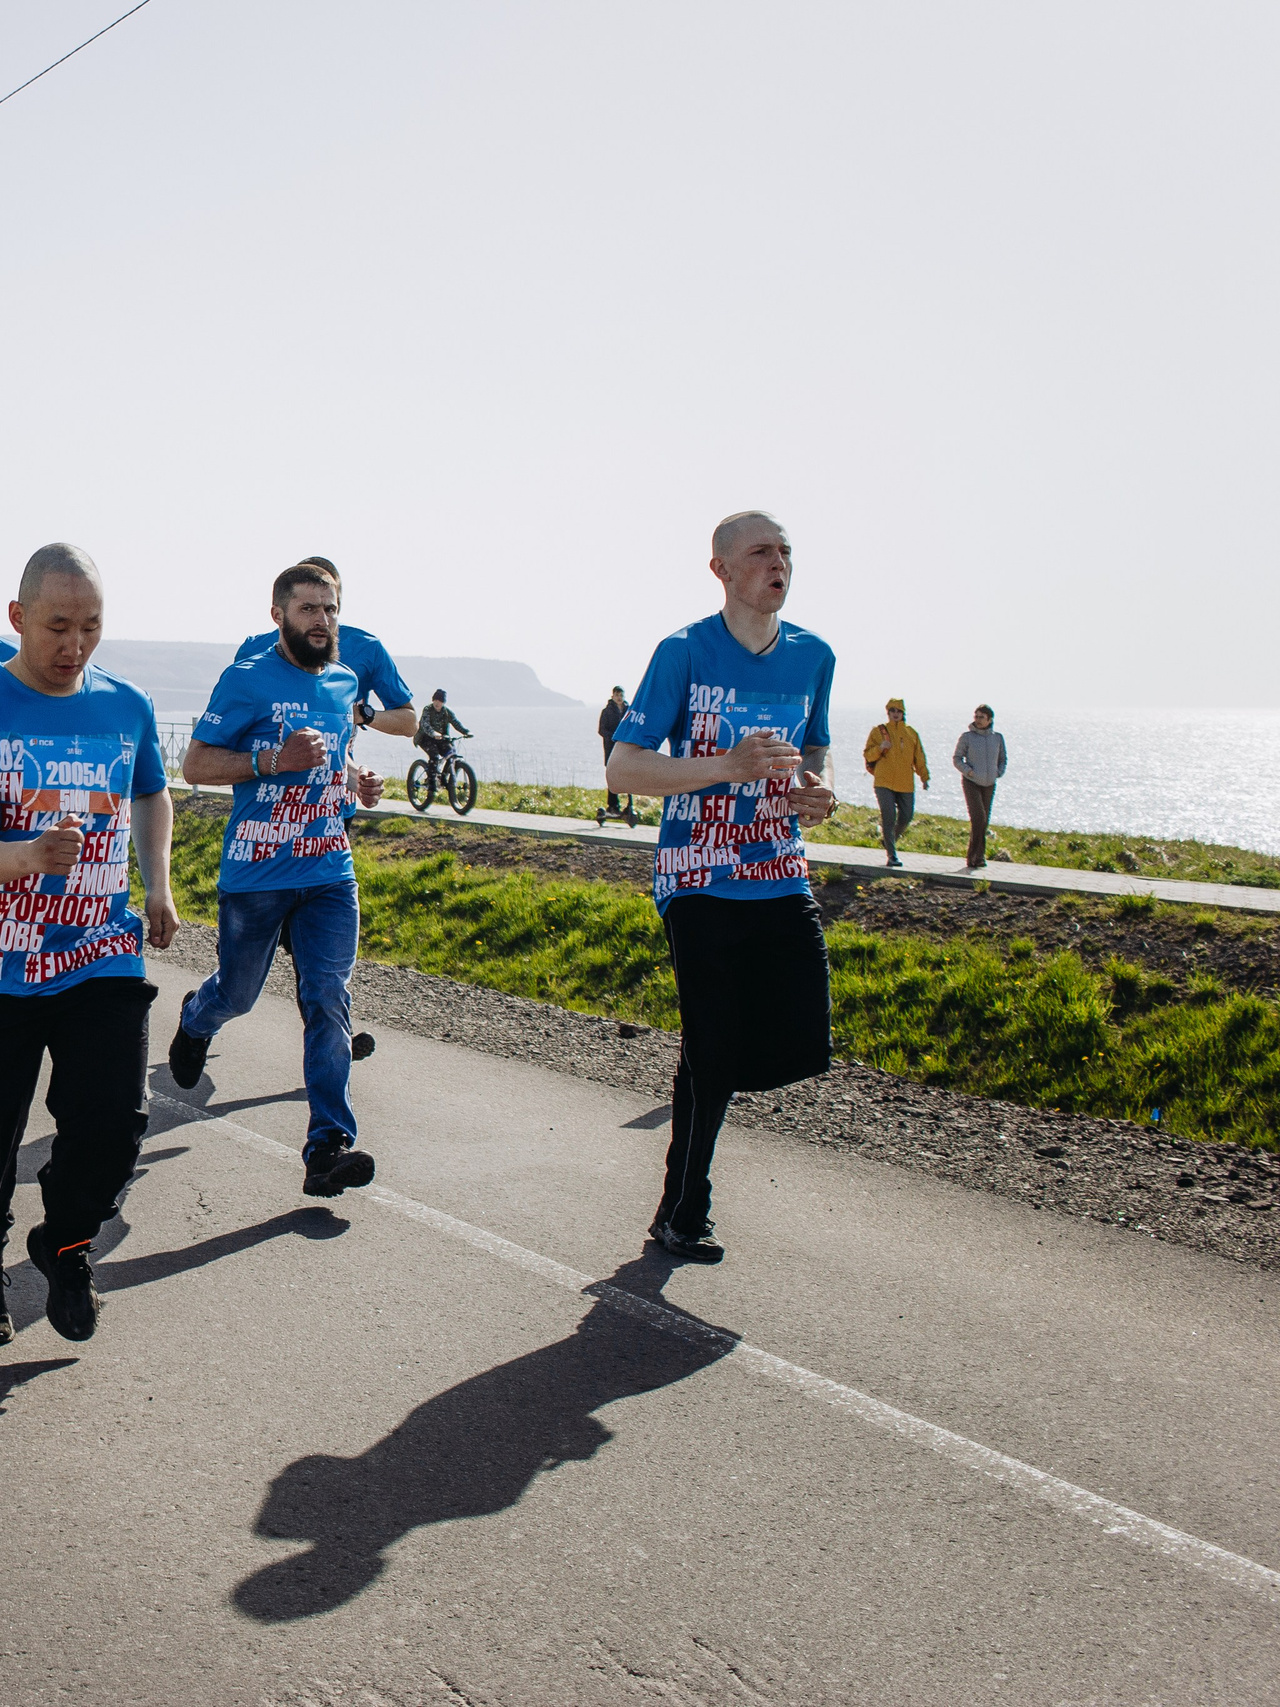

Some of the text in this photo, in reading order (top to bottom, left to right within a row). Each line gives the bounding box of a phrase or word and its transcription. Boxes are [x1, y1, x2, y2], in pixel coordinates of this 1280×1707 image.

[689, 683, 736, 713] 2024
[38, 739, 55, 747] ПСБ
[739, 725, 789, 743] 251
[45, 761, 108, 788] 20054
[60, 789, 90, 813] 5КМ
[256, 783, 311, 803] #ЗАБЕГ
[666, 794, 736, 822] #ЗАБЕГ
